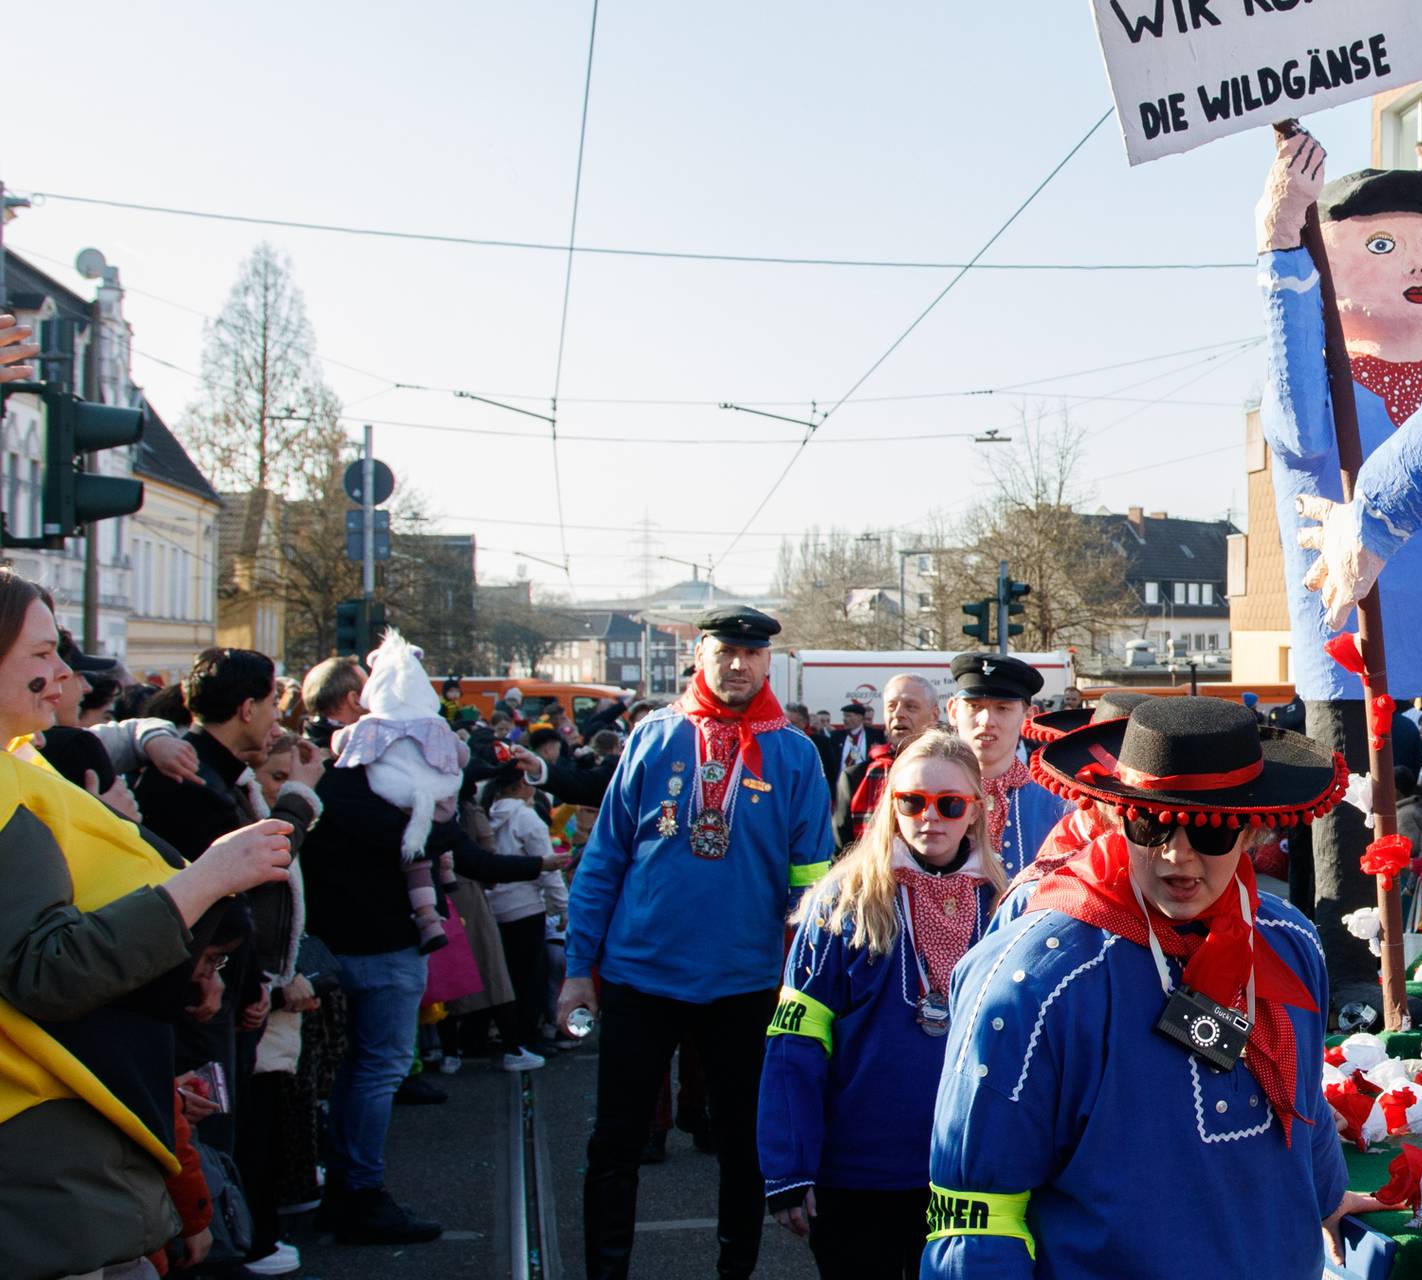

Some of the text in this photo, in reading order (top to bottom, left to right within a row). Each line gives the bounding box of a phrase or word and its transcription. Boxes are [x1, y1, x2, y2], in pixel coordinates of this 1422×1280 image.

[1139, 33, 1391, 140] DIE WILDGÄNSE
[1214, 1006, 1233, 1022] Gucki
